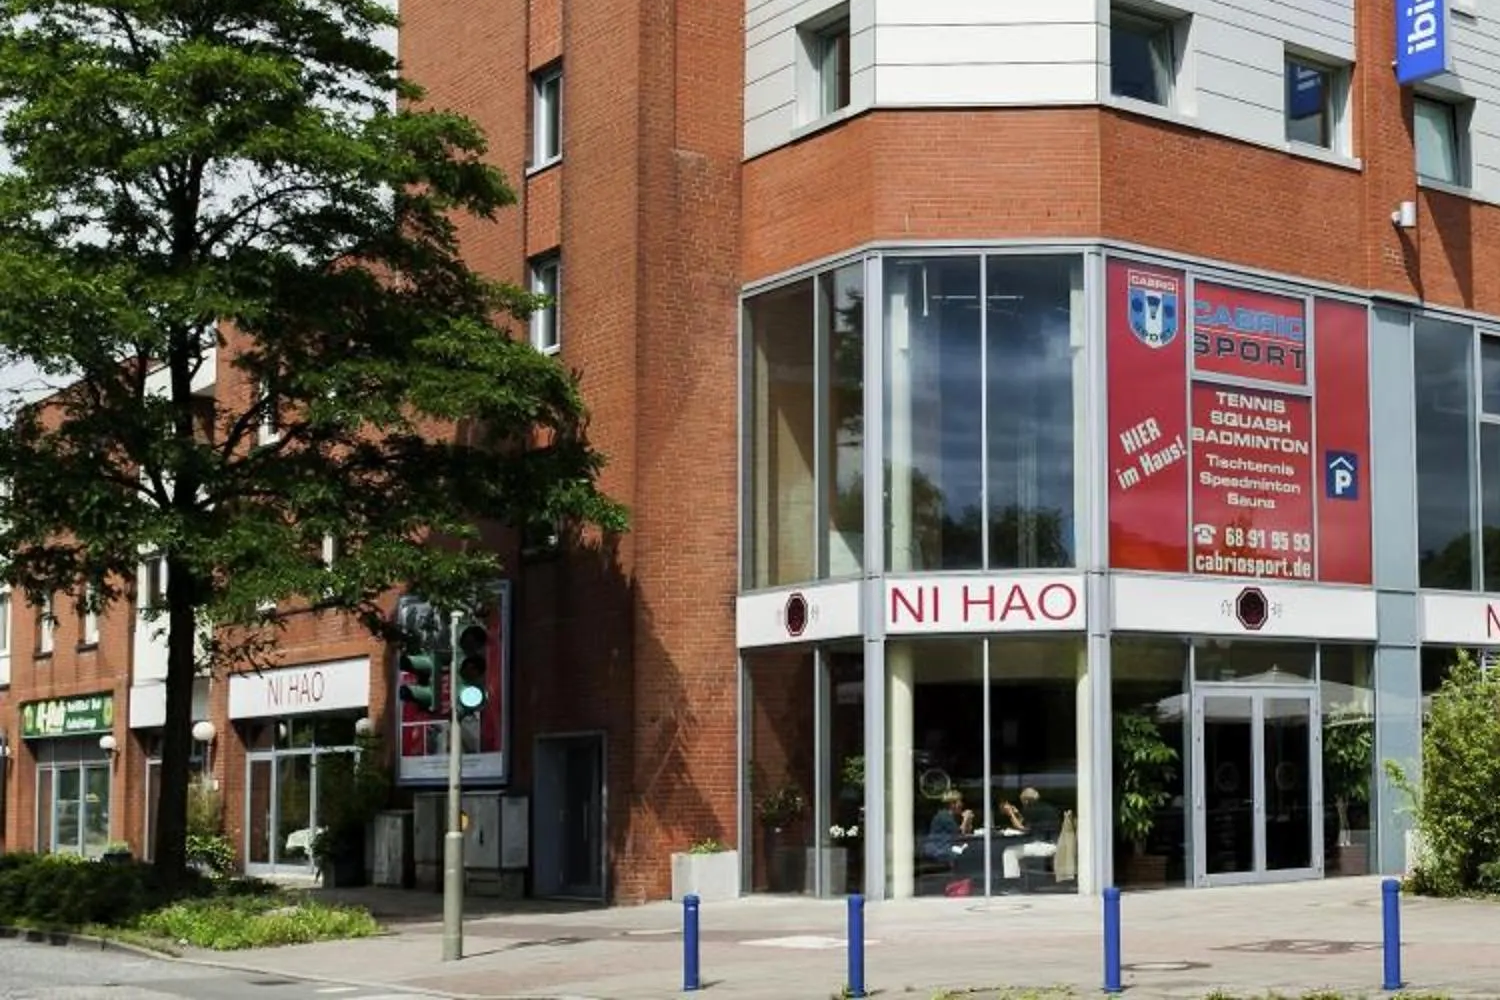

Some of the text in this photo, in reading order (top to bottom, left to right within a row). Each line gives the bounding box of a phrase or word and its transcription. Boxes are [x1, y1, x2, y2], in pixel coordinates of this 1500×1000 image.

[1194, 332, 1304, 369] SPORT
[1215, 391, 1286, 413] TENNIS
[1210, 410, 1291, 433] SQUASH
[1120, 417, 1161, 455] HIER
[1191, 427, 1309, 455] BADMINTON
[1115, 434, 1187, 490] im Haus!
[1206, 453, 1295, 477] Tischtennis
[1199, 471, 1301, 495] Speedminton
[1335, 469, 1352, 495] P
[1226, 492, 1276, 509] Sauna
[1225, 527, 1244, 548] 68
[1247, 529, 1265, 549] 91
[1293, 533, 1311, 553] 93
[1195, 550, 1311, 578] cabriosport.de
[890, 582, 1077, 624] NI HAO
[267, 671, 325, 707] NI HAO
